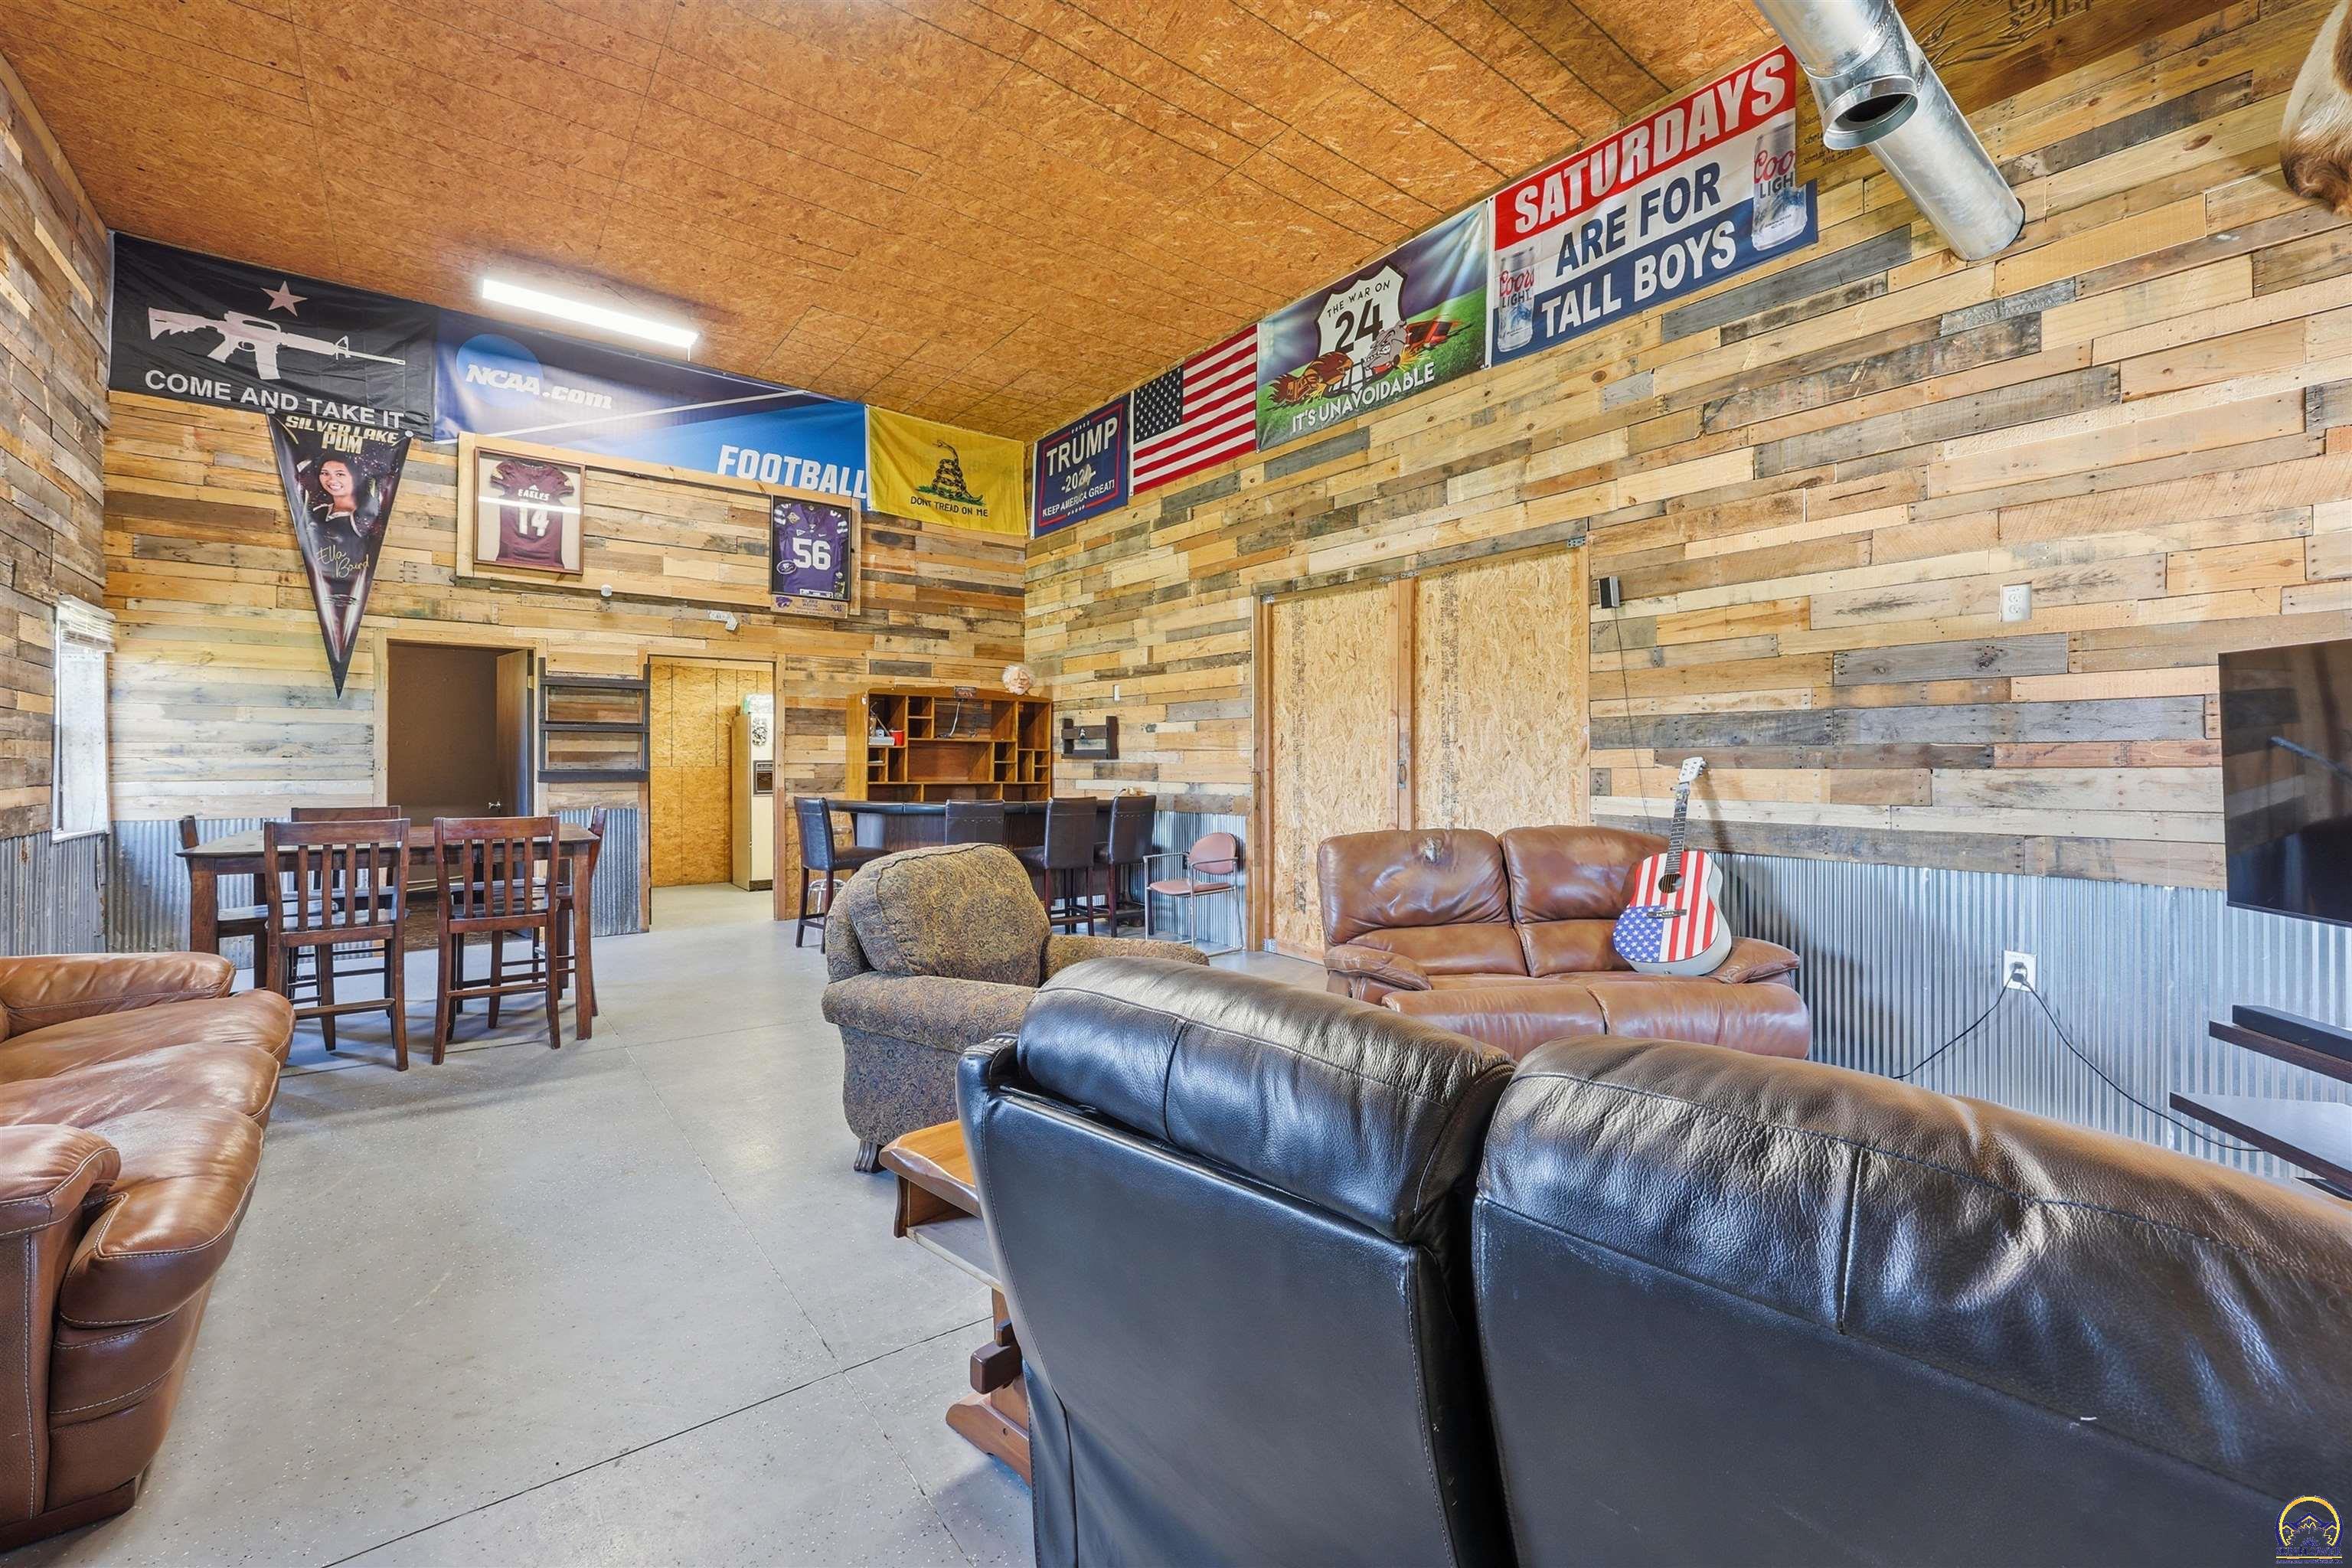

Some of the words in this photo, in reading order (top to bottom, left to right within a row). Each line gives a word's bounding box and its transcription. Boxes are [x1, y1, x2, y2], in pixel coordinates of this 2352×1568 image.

[1514, 54, 1786, 234] SATURDAYS
[1754, 150, 1795, 184] Coo
[1759, 171, 1794, 199] LIGH
[1556, 204, 1628, 279] ARE
[1639, 161, 1721, 239] FOR
[1327, 299, 1344, 318] THE
[1348, 287, 1370, 303] WAR
[1374, 279, 1390, 292] ON
[1541, 273, 1622, 338] TALL
[1634, 219, 1737, 303] BOYS
[1334, 298, 1383, 353] 24
[145, 369, 231, 402] COME
[240, 387, 299, 411] AND
[306, 397, 375, 425] TAKE
[383, 410, 405, 429] IT
[466, 364, 612, 410] NCAA.com
[1292, 408, 1317, 433] IT'S
[1319, 361, 1436, 422] UNAVOIDABLE
[285, 415, 351, 437] SILVER
[353, 426, 399, 444] LAKE
[1046, 416, 1118, 477] TRUMP
[717, 444, 867, 499] FOOTBALL
[518, 498, 550, 537] 14
[934, 501, 959, 513] TREAD
[962, 507, 972, 515] ON
[1042, 504, 1060, 518] KEEP
[1060, 491, 1087, 511] AMERICA
[318, 544, 347, 564] Ella
[792, 537, 831, 570] 56
